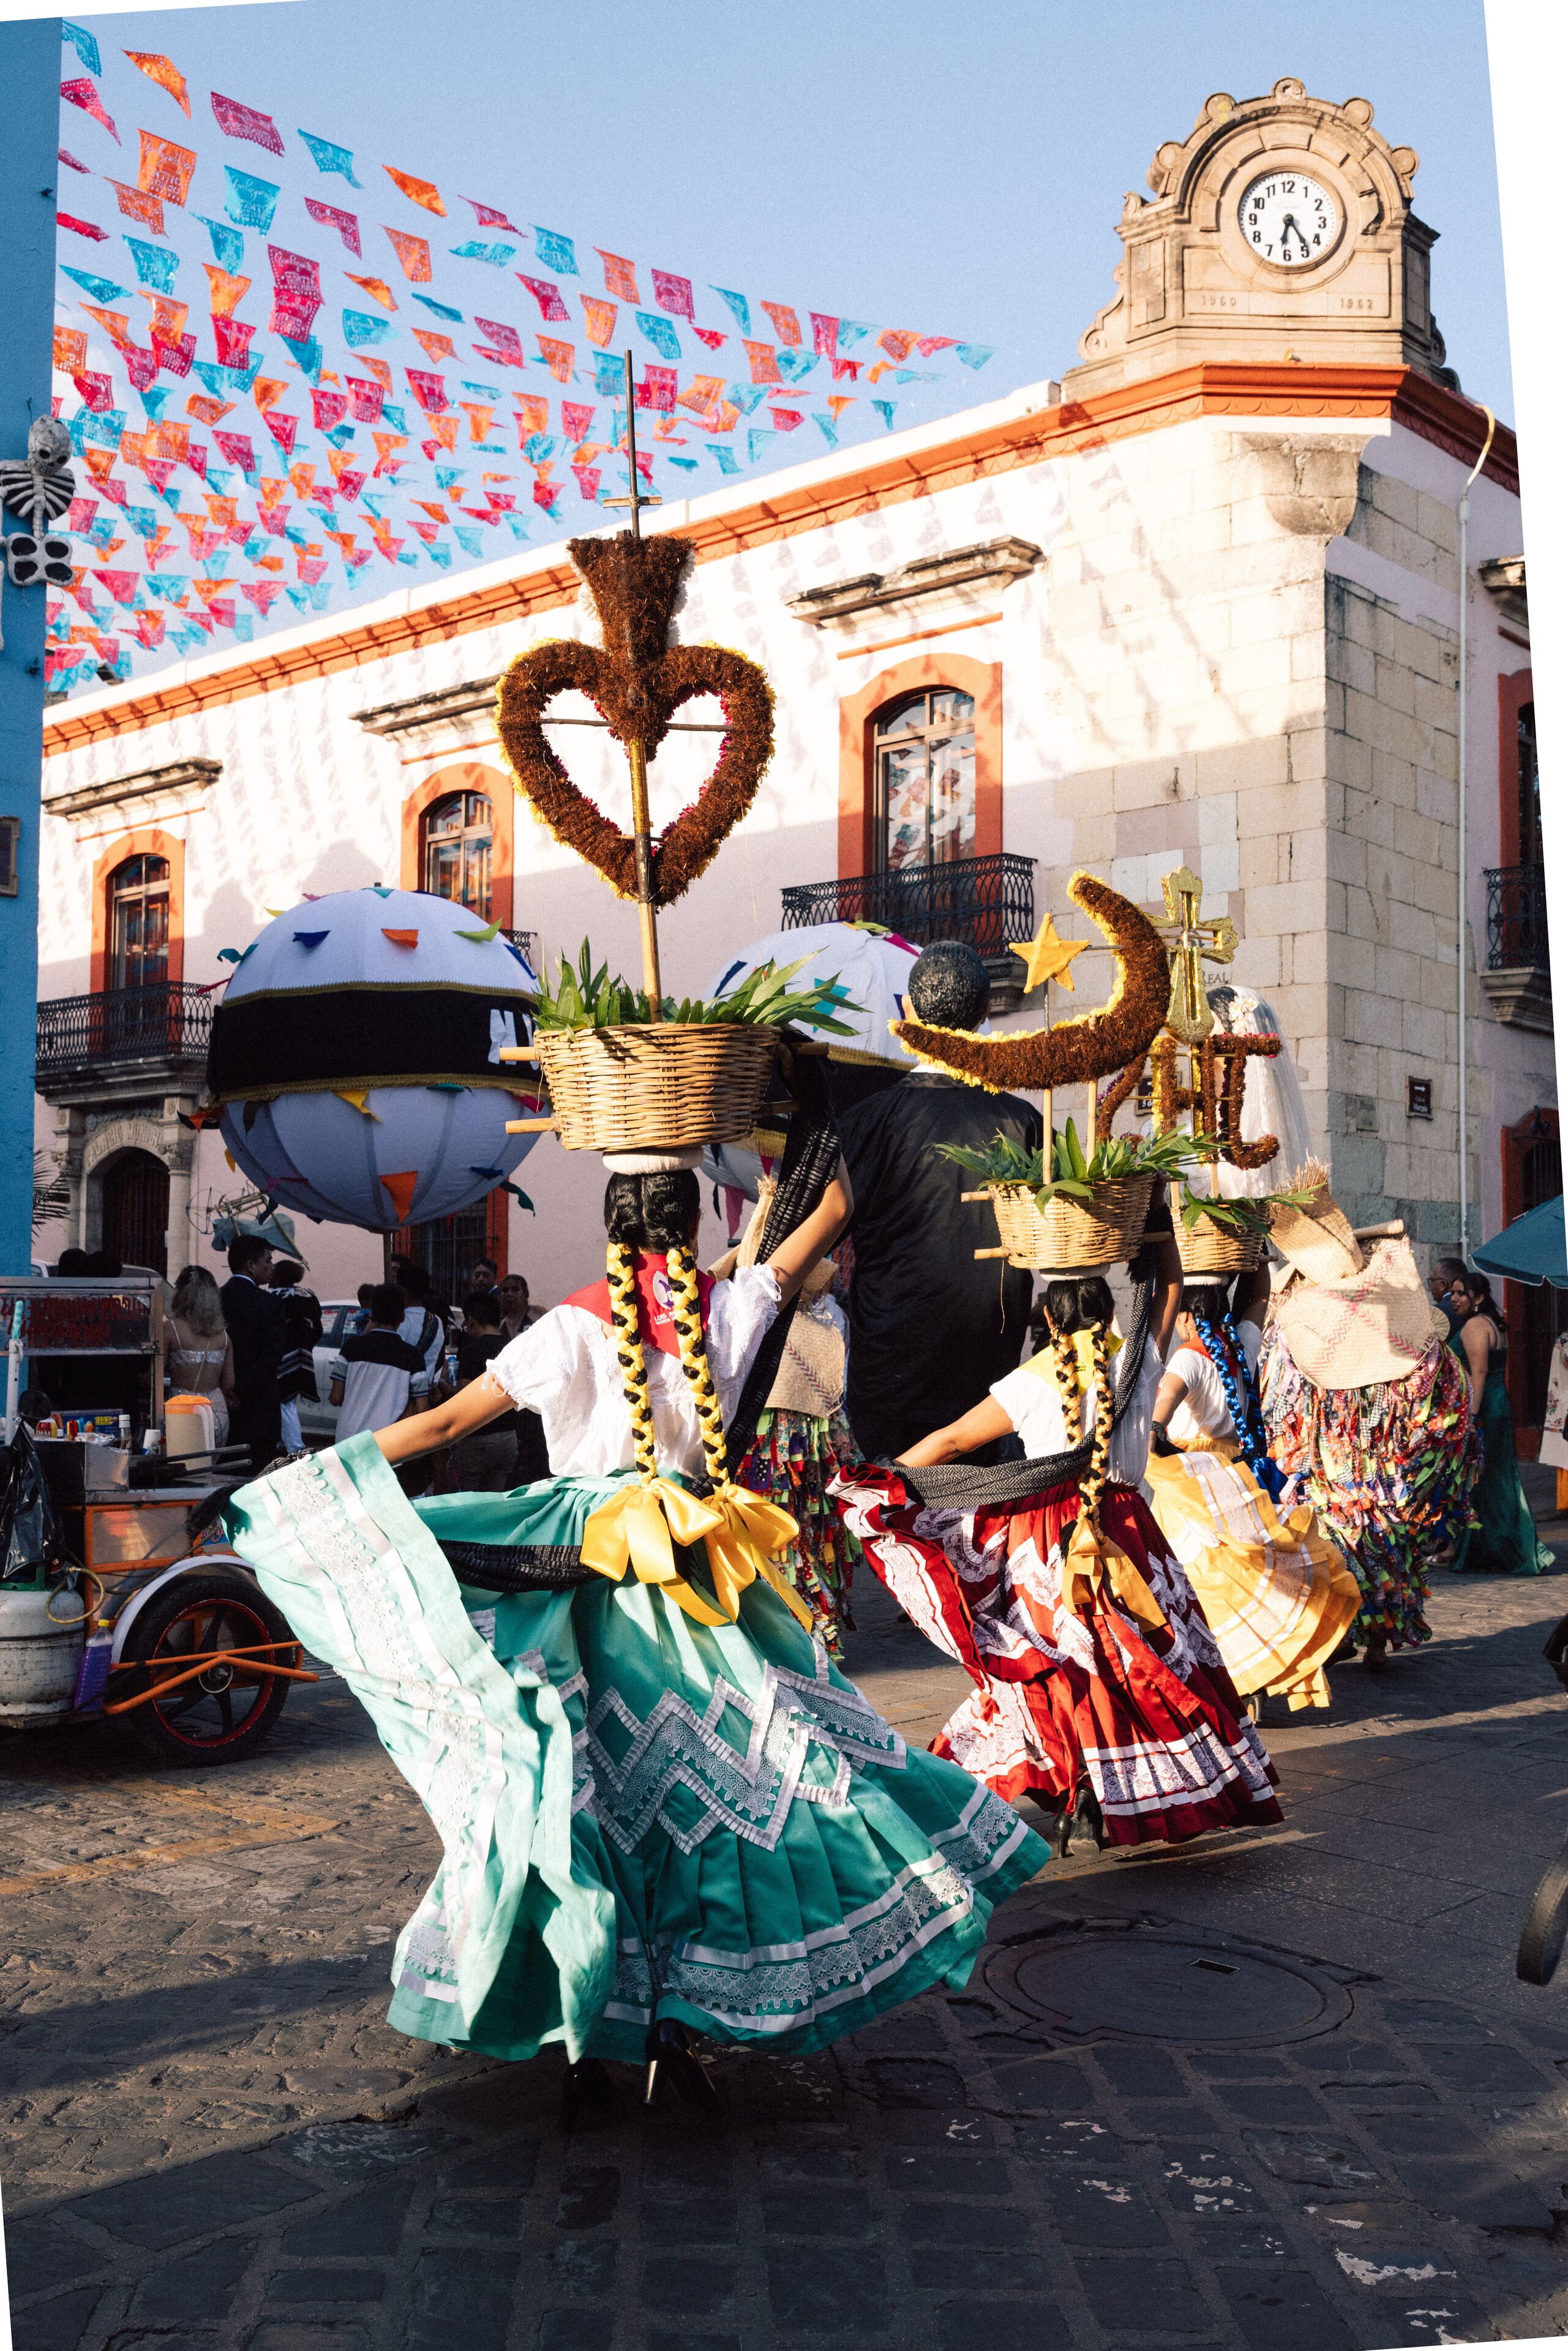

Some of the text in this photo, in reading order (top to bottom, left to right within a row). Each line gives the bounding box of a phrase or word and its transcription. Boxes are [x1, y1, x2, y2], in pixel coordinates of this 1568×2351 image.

[1266, 184, 1275, 198] 11
[1281, 181, 1296, 193] 12
[1303, 186, 1308, 198] 1
[1252, 198, 1265, 209] 10
[1314, 198, 1323, 211] 2
[1249, 214, 1257, 225] 9
[1318, 217, 1327, 229] 3
[1253, 231, 1261, 243] 8
[1313, 233, 1321, 246] 4
[1265, 244, 1274, 257] 7
[1283, 249, 1291, 261] 6
[1301, 245, 1310, 258] 5
[653, 1313, 667, 1322] LUIS
